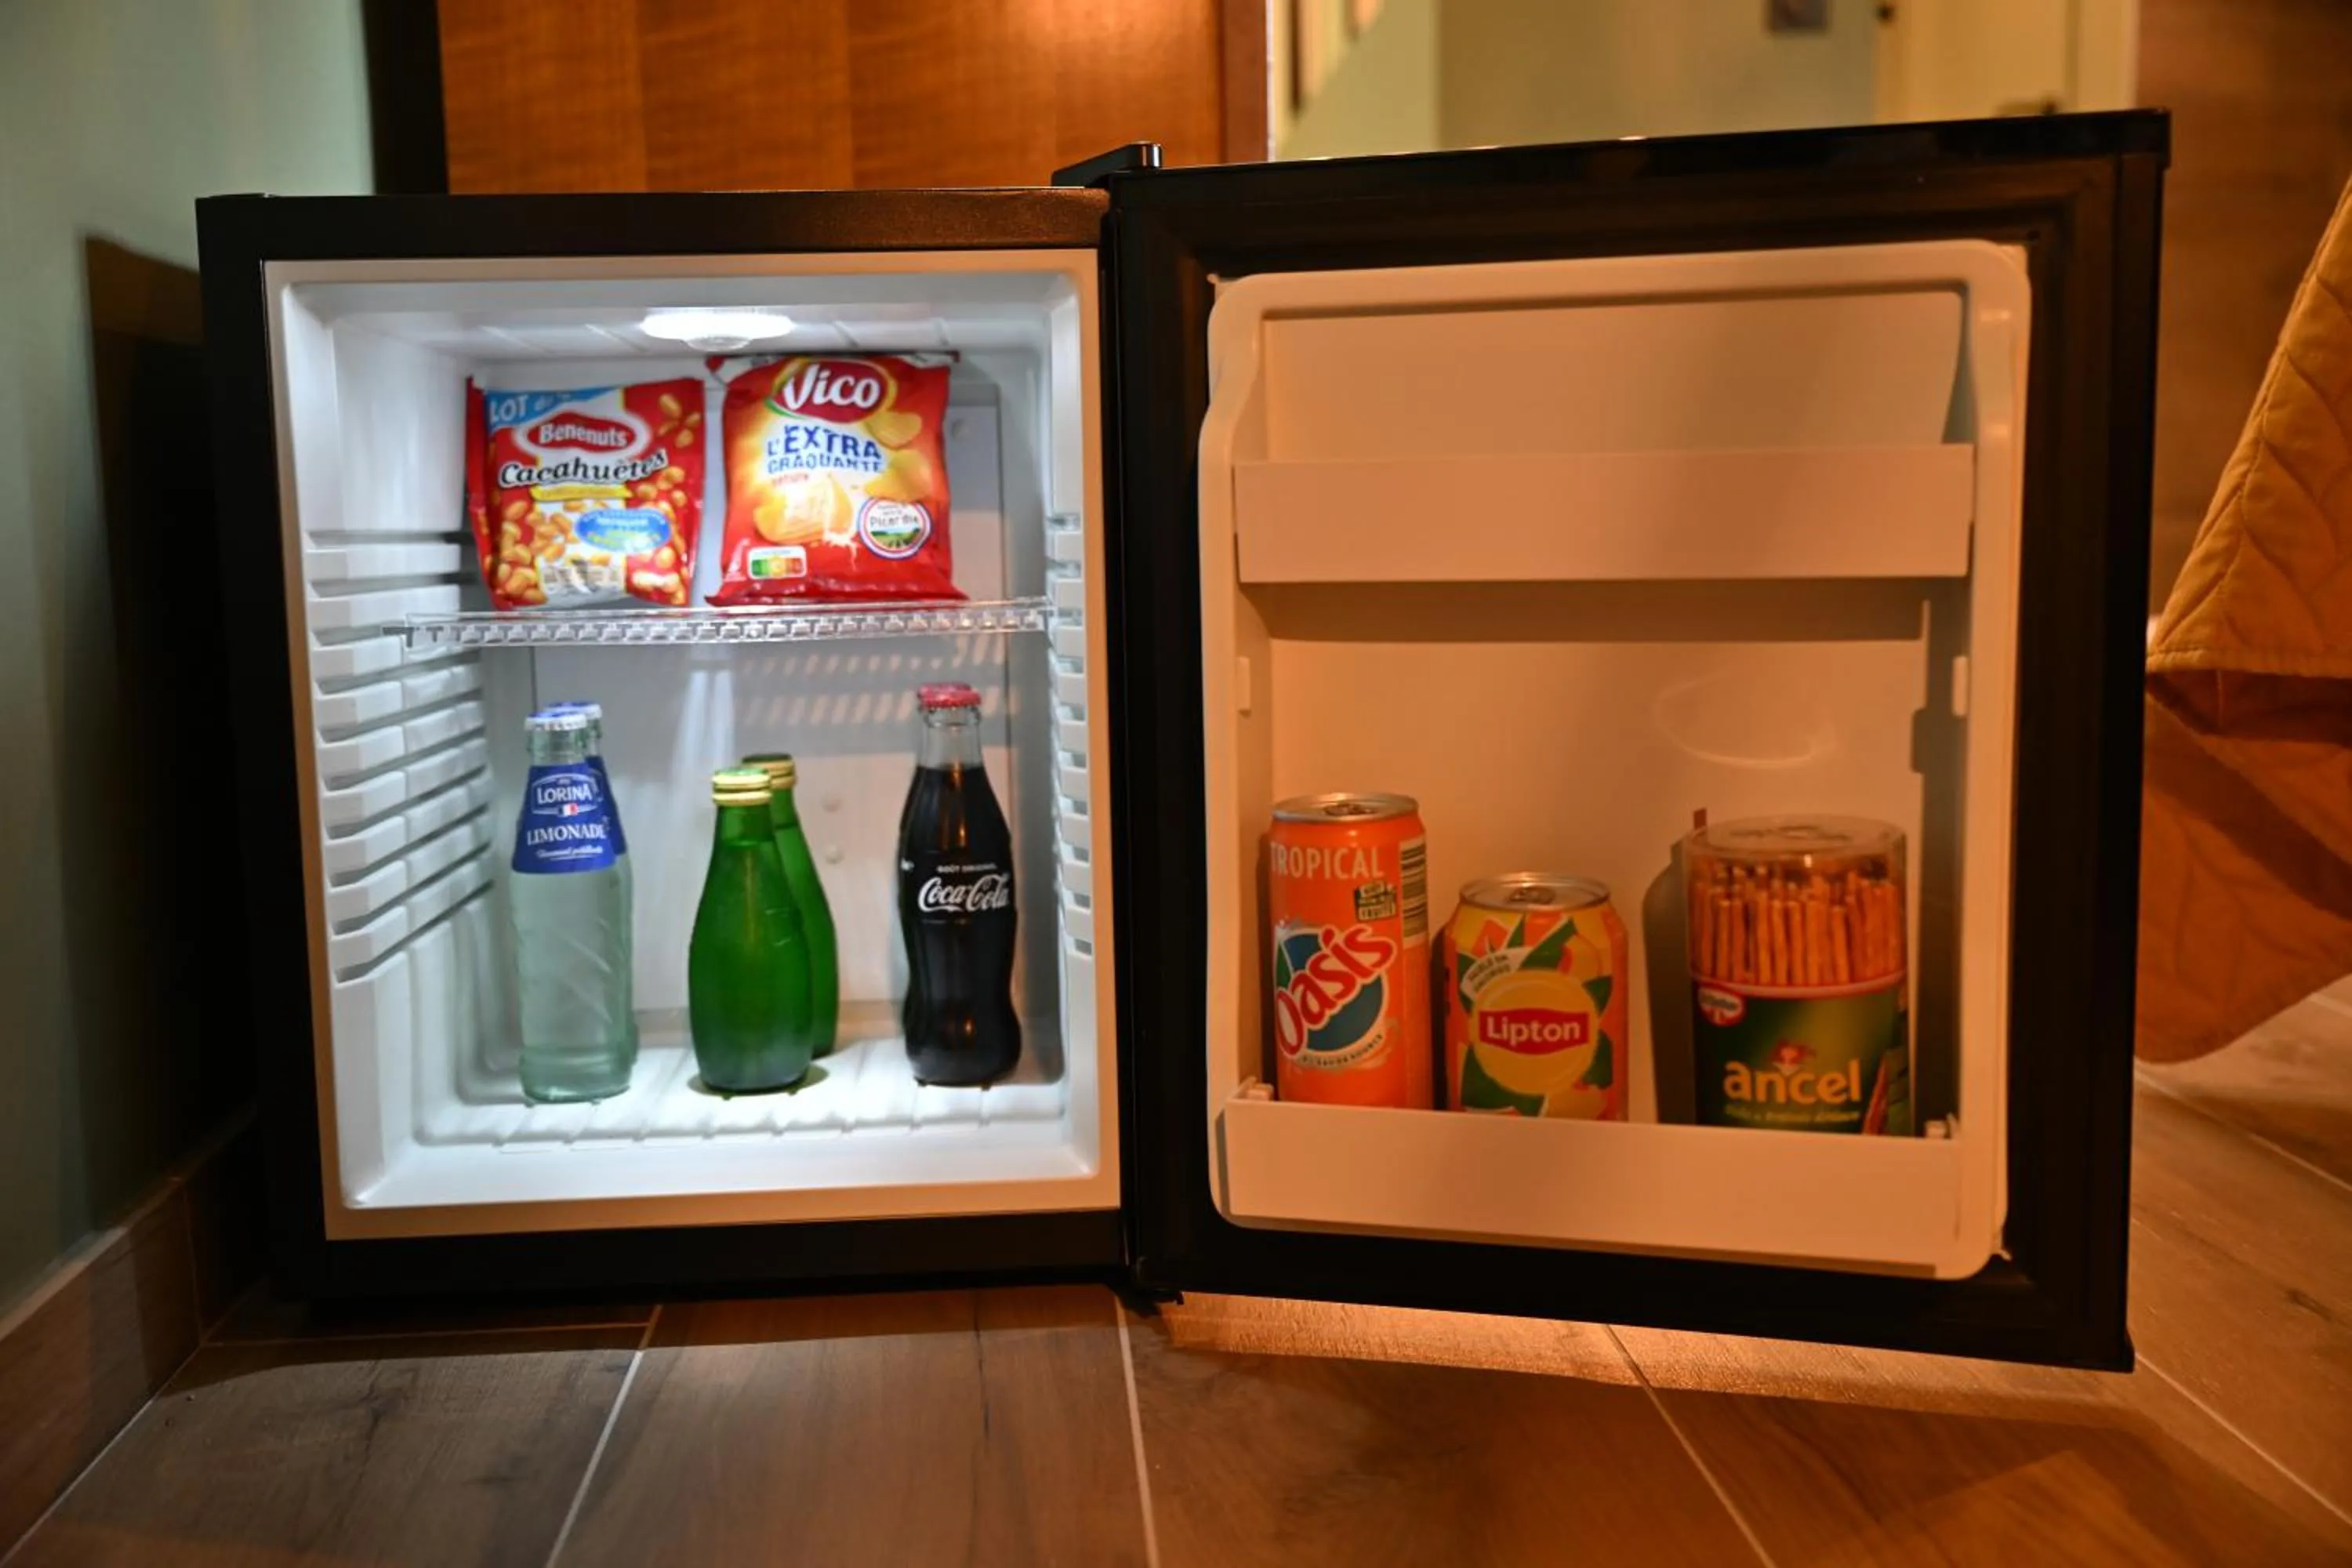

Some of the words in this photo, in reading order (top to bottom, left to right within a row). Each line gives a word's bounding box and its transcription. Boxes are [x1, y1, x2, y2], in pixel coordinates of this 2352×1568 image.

[782, 363, 881, 410] Vico
[489, 394, 529, 426] LOT
[538, 423, 629, 448] Benenuts
[768, 426, 881, 459] L'EXTRA
[537, 784, 593, 804] LORINA
[918, 873, 1010, 913] Coca-Cola
[1276, 925, 1396, 1057] Oasis
[1486, 1016, 1581, 1047] Lipton
[1723, 1059, 1861, 1105] ancel
